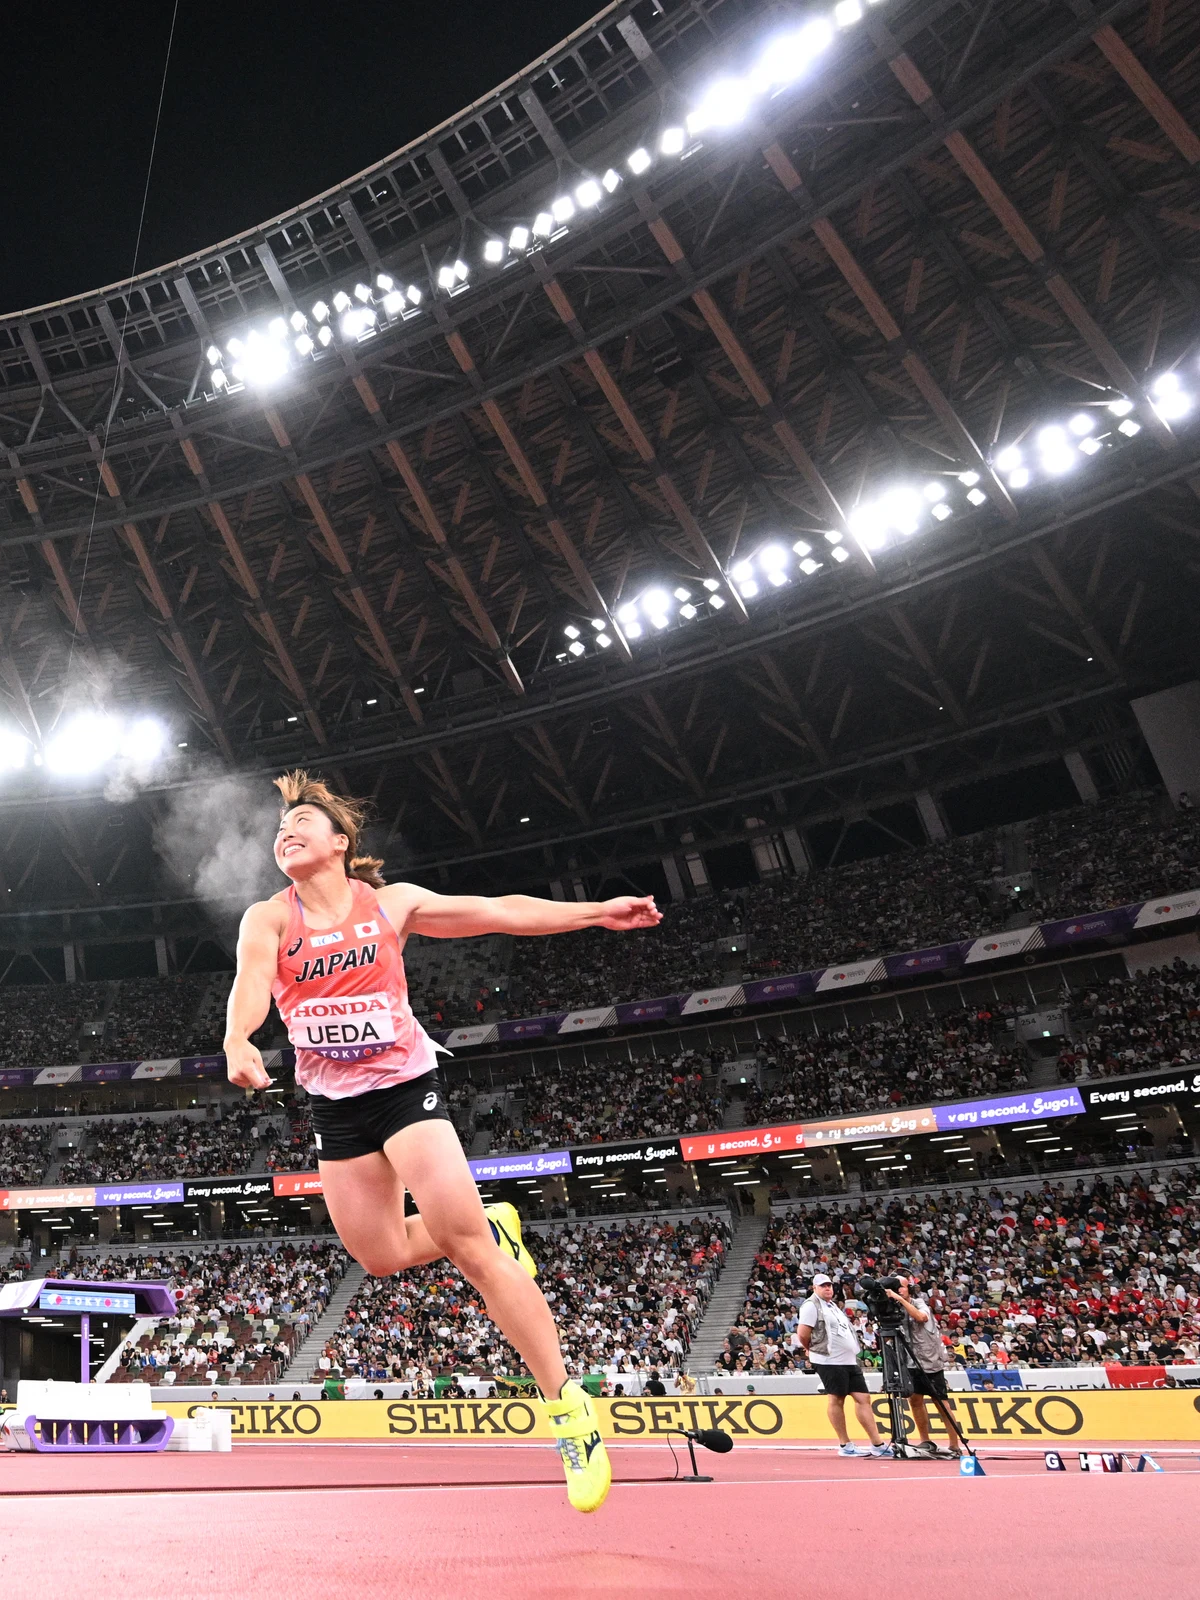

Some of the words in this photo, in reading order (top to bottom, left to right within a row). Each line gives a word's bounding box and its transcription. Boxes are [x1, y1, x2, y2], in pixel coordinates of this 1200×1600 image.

[295, 943, 377, 983] JAPAN
[293, 999, 387, 1018] HONDA
[307, 1022, 380, 1045] UEDA
[1090, 1091, 1130, 1103] Every
[1134, 1080, 1188, 1097] second,
[981, 1103, 1029, 1118] second,
[1032, 1096, 1078, 1114] Sugoi.
[720, 1138, 759, 1150] second,
[500, 1162, 534, 1172] second,
[536, 1158, 568, 1172] Sugoi.
[576, 1156, 603, 1165] Every
[606, 1150, 642, 1162] second,
[644, 1147, 678, 1161] Sugoi.
[123, 1190, 152, 1199] second,
[153, 1188, 181, 1200] Sugoi.
[188, 1188, 210, 1197] Every
[212, 1185, 242, 1194] second,
[243, 1183, 270, 1195] Sugoi.
[387, 1402, 535, 1434] SEIKO
[610, 1399, 783, 1435] SEIKO
[960, 1457, 974, 1473] C
[1046, 1454, 1059, 1468] G
